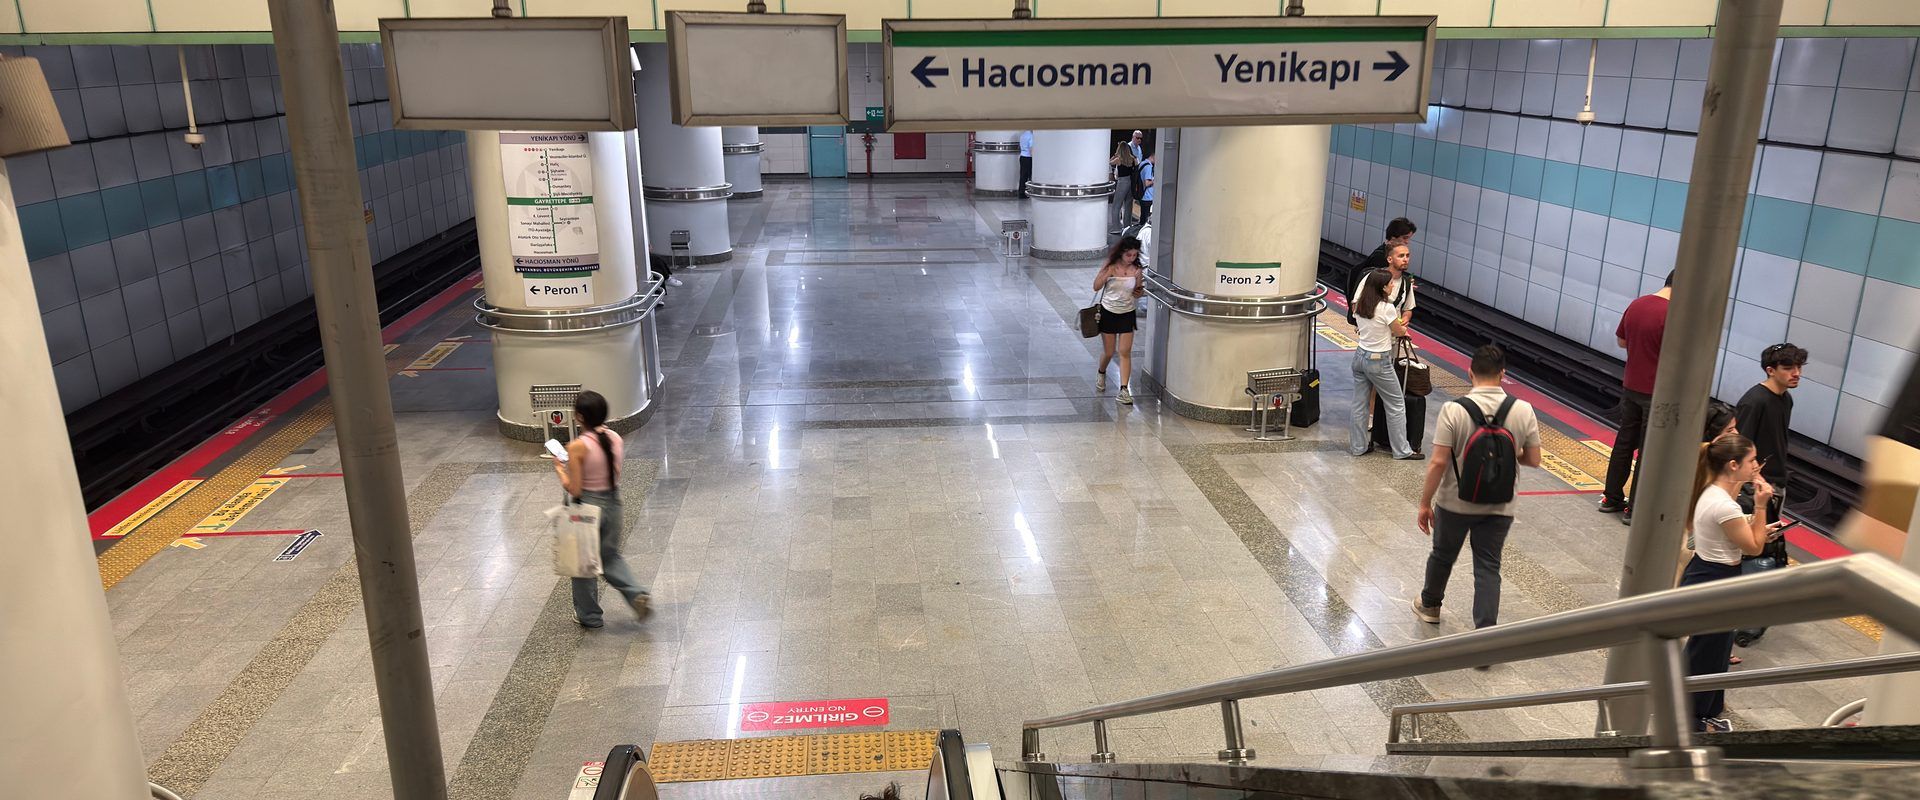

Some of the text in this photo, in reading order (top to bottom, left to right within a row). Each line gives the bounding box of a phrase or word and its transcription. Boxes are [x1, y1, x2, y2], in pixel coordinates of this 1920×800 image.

[962, 57, 1152, 88] Hacıosman
[1214, 51, 1361, 90] Yenikapı
[1220, 274, 1261, 285] Peron 2
[544, 284, 587, 295] Peron 1
[772, 712, 859, 724] GİRİLMEZ
